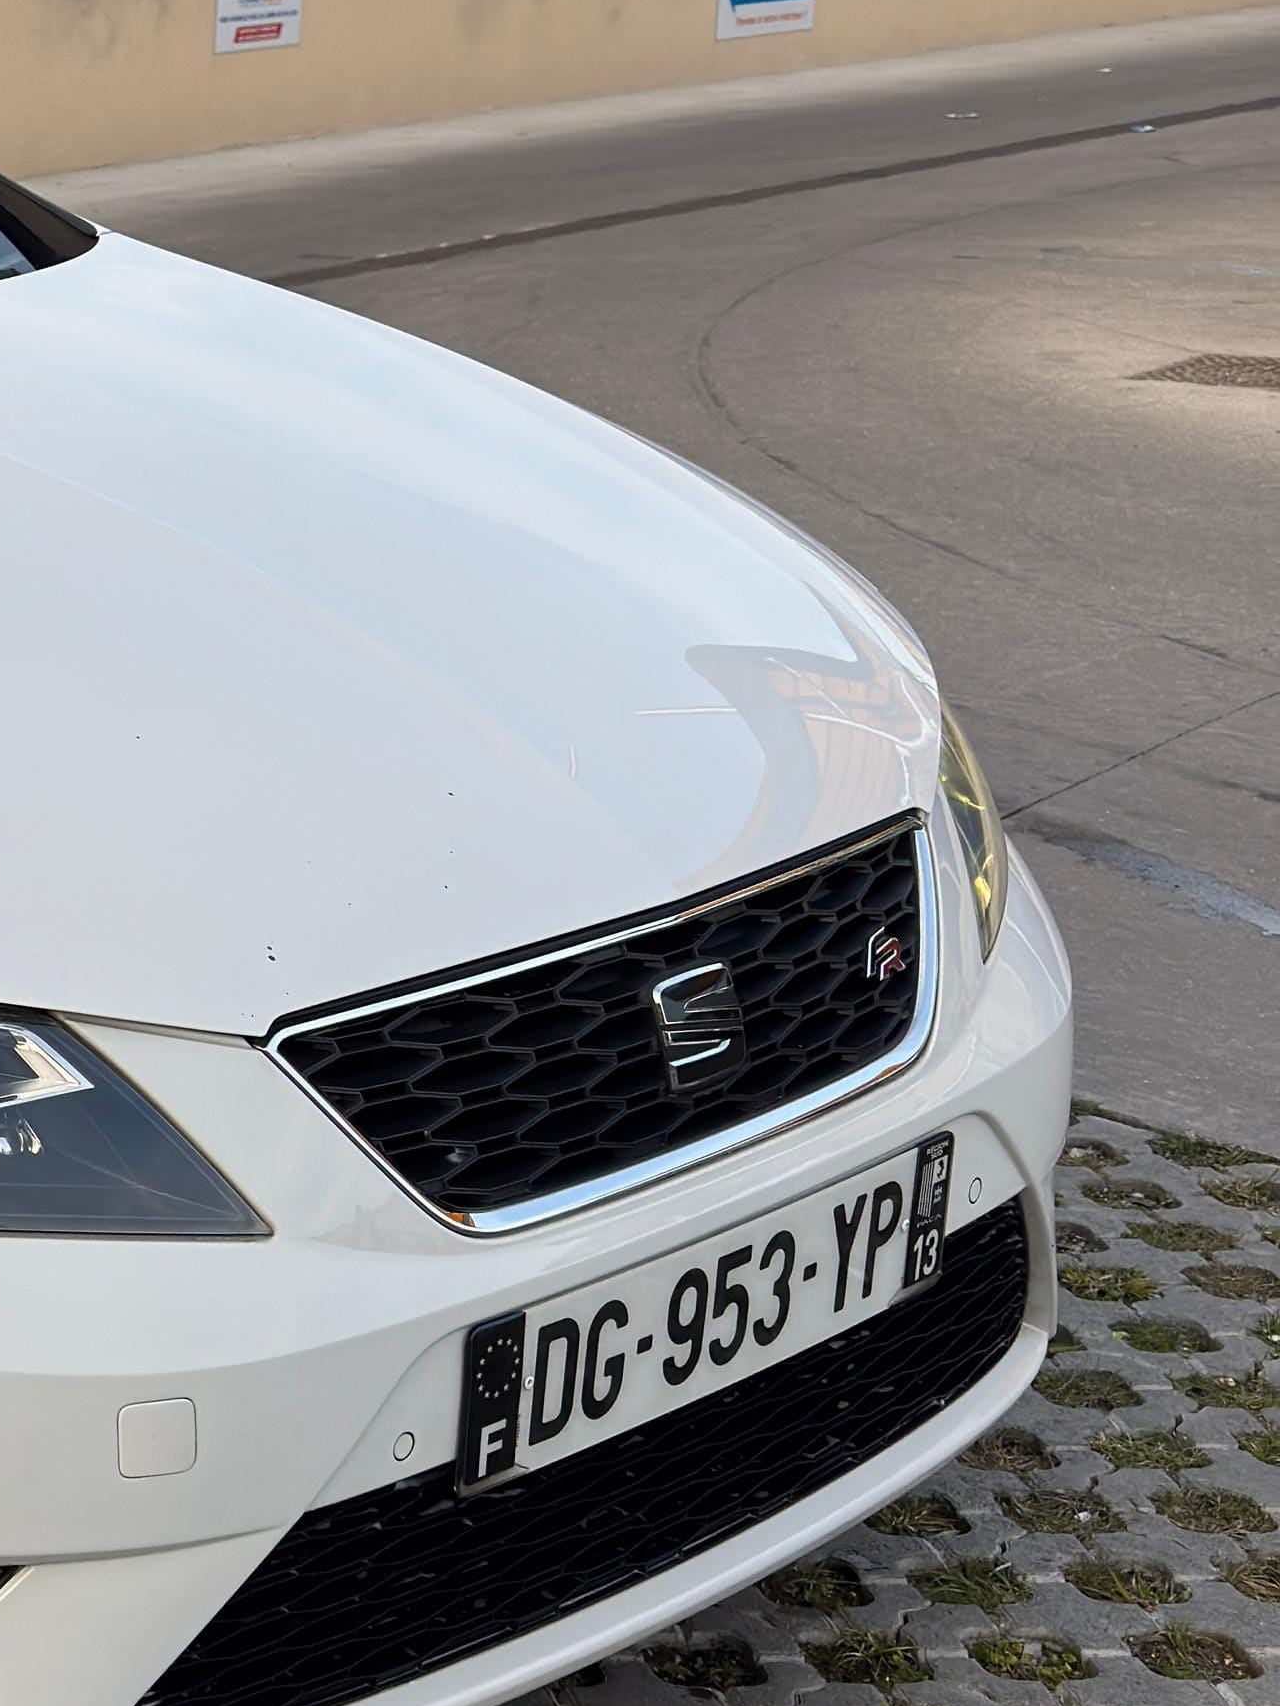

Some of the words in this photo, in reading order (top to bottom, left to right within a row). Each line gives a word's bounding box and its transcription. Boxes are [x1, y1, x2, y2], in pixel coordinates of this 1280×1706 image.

[912, 1228, 939, 1282] 13
[528, 1180, 903, 1446] DG-953-YP
[477, 1417, 507, 1478] F
